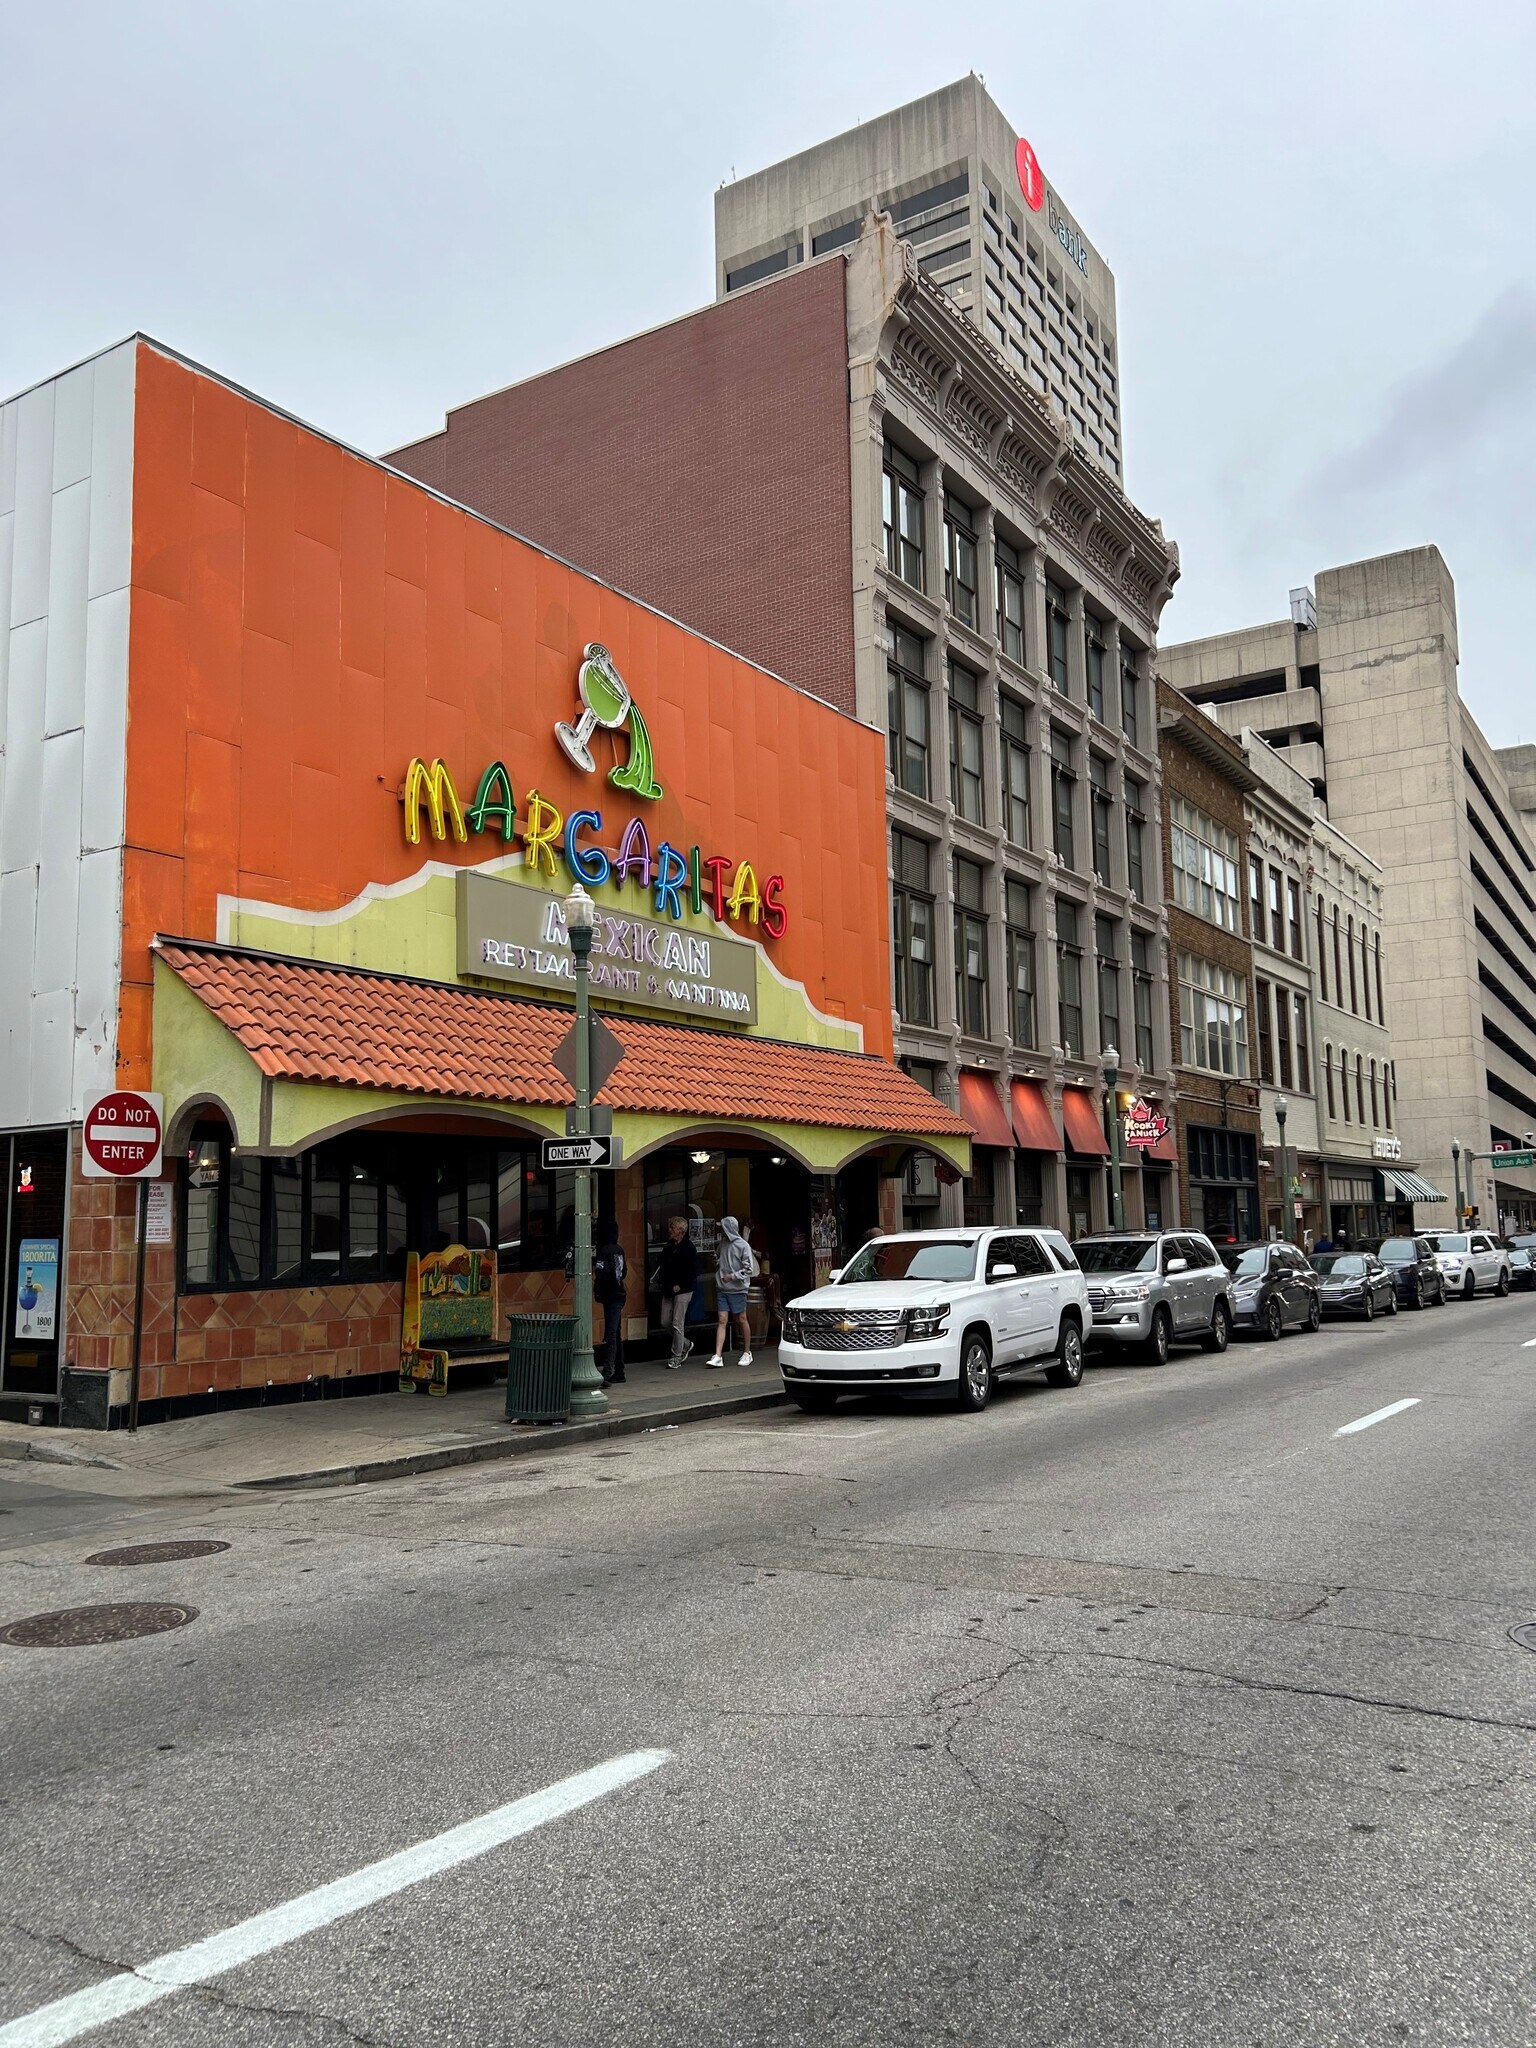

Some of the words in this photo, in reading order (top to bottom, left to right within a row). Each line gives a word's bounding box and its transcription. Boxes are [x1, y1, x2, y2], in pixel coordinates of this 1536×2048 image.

[1046, 190, 1089, 279] bank
[404, 757, 788, 940] MARGARITAS
[98, 1107, 117, 1121] DO
[125, 1109, 151, 1123] NOT
[102, 1145, 145, 1160] ENTER
[551, 1148, 569, 1159] ONE
[572, 1146, 592, 1158] WAY
[1494, 1159, 1514, 1167] Union
[22, 1251, 57, 1263] 1800RITA
[37, 1316, 52, 1326] 1800
